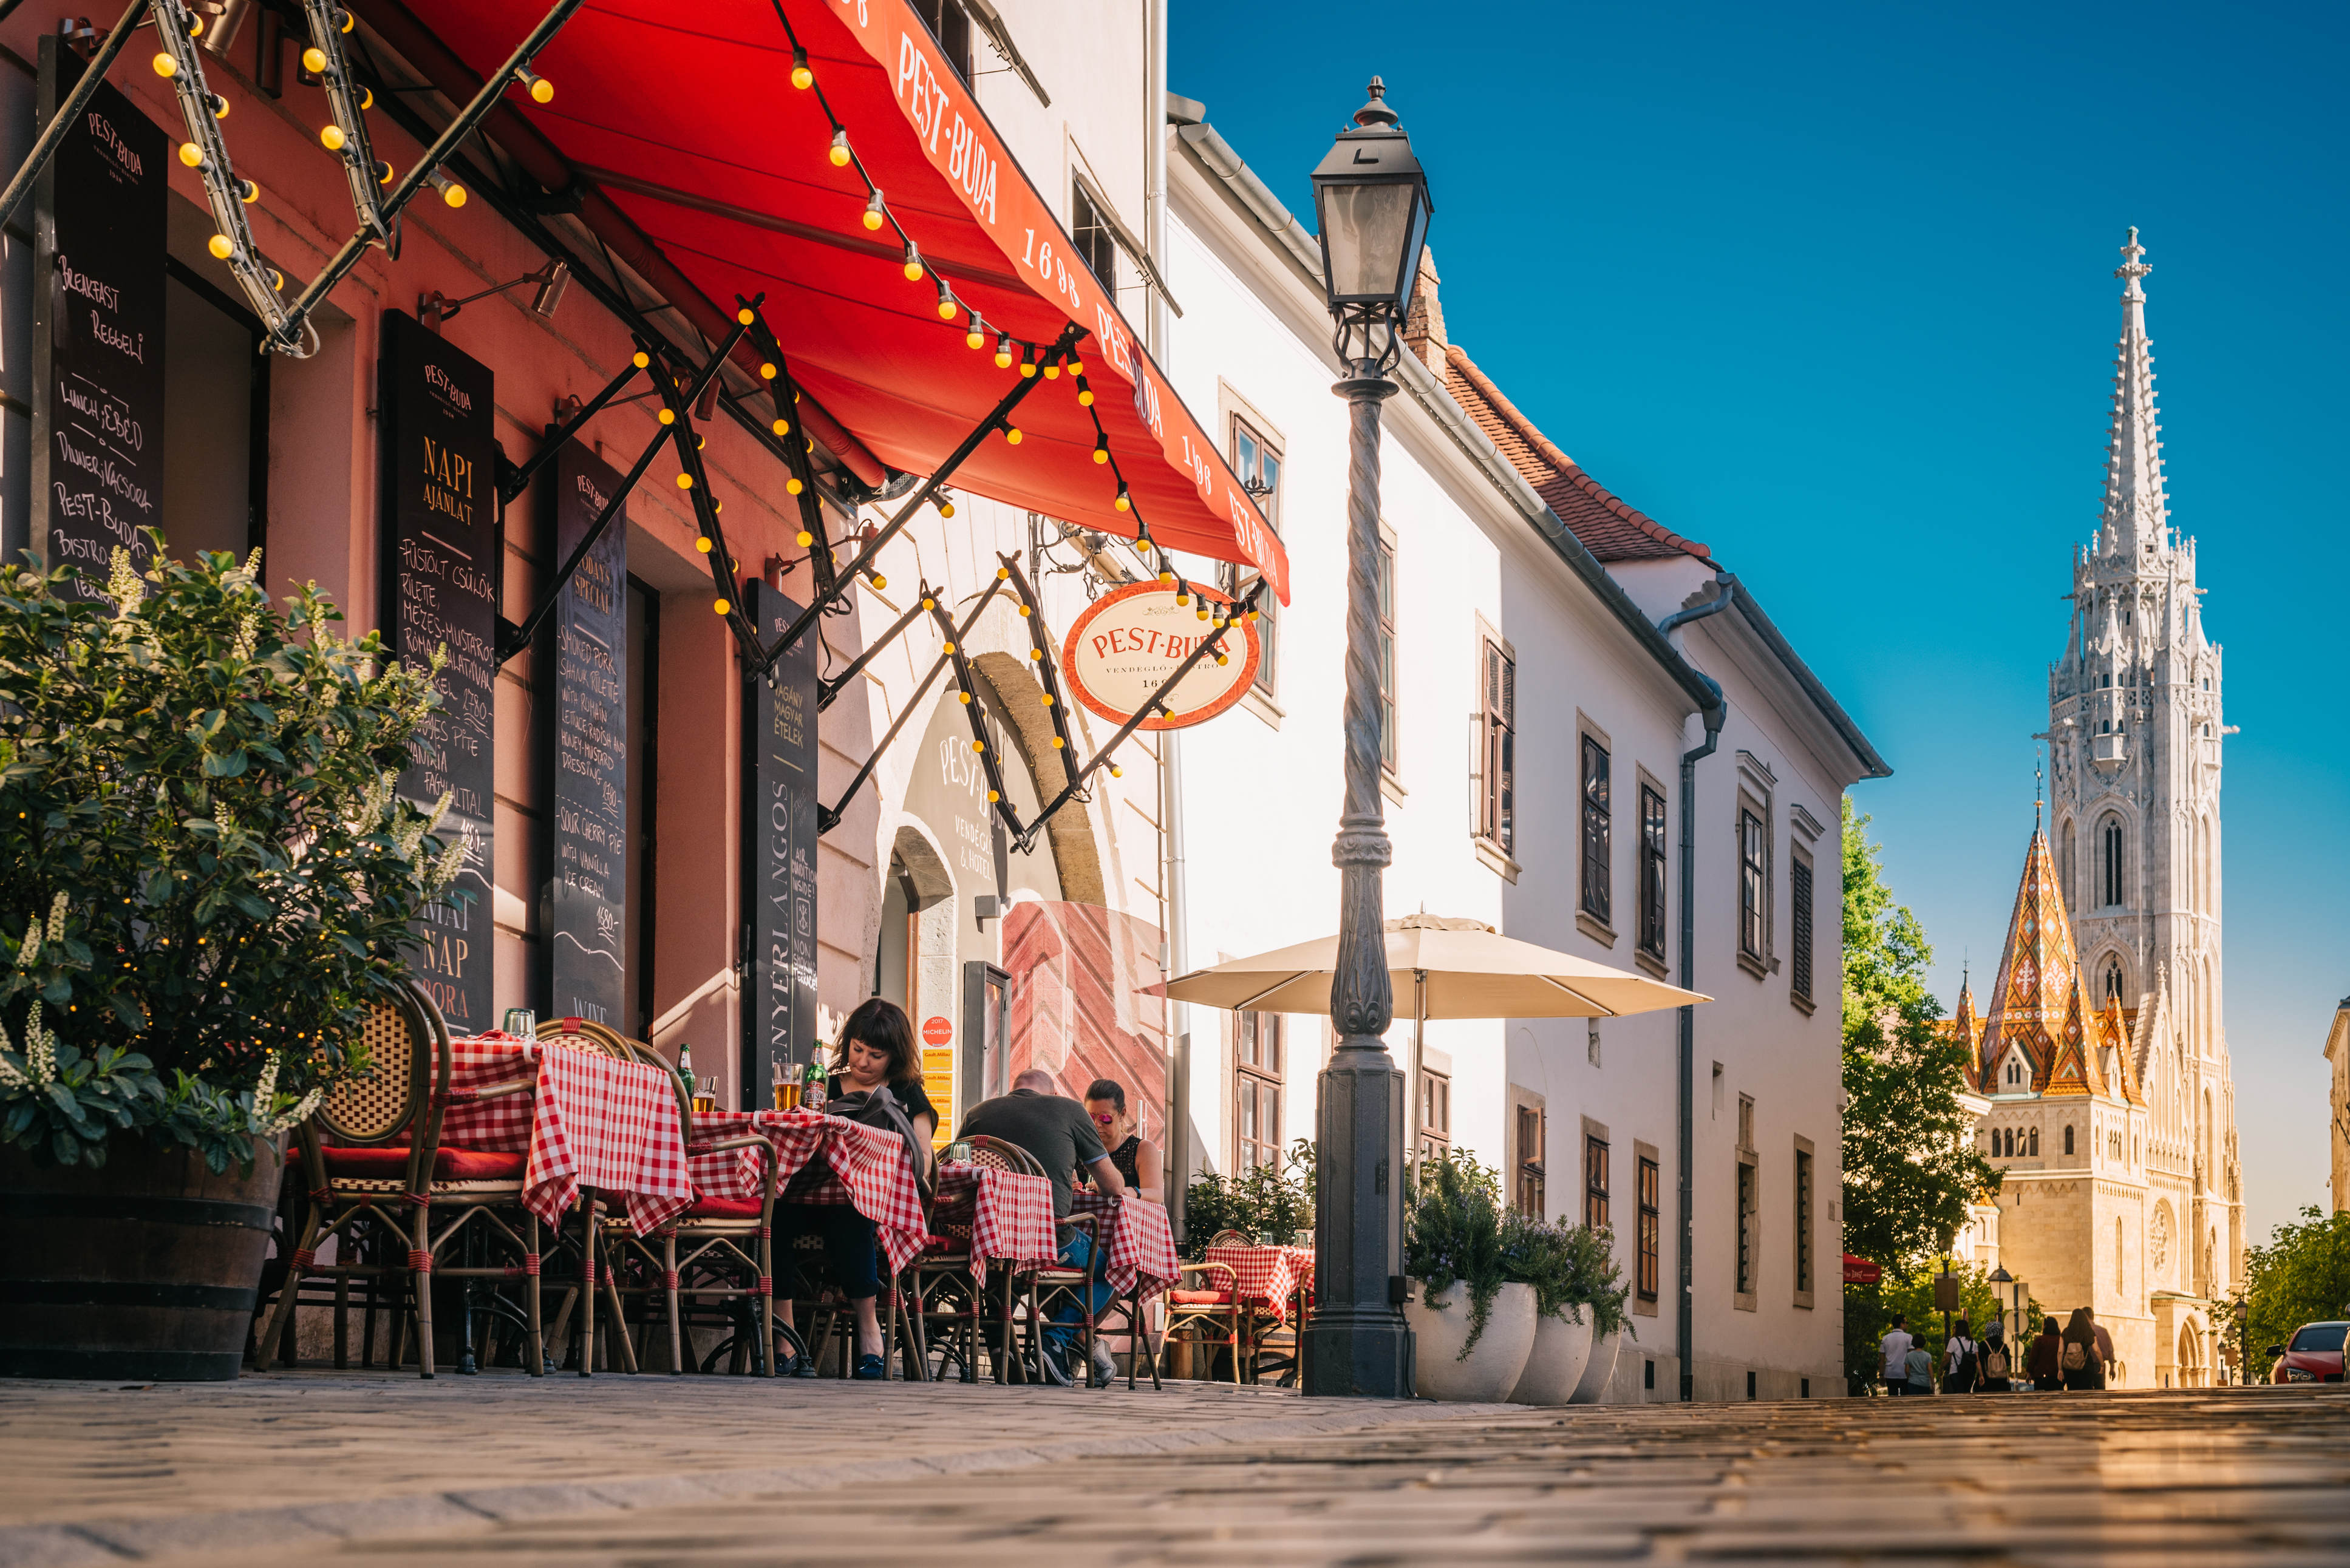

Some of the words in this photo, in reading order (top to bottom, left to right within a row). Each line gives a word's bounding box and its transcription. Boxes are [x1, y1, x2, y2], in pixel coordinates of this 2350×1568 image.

[88, 113, 143, 175] PEST·BUDA
[898, 31, 997, 225] PEST·BUDA
[424, 364, 472, 410] PEST·BUDA
[424, 435, 473, 499] NAPI
[53, 481, 148, 559] PEST-BUDA
[423, 483, 473, 526] AJÁNLAT
[53, 528, 107, 566] BISTRO
[1227, 486, 1279, 588] EST·BUDA
[577, 554, 611, 587] ODAY'S
[559, 657, 590, 688] SHANK
[593, 647, 618, 676] PORK
[774, 699, 804, 728] MAGYAR
[774, 713, 803, 750] ÉTELEK
[795, 847, 808, 866] AIR
[969, 848, 992, 881] HOTEL
[579, 876, 605, 901] CREAM
[423, 929, 468, 978] NAP
[769, 780, 788, 1099] ENYÉRLÁNGOS
[794, 937, 811, 959] NON
[793, 953, 817, 977] SMOKING
